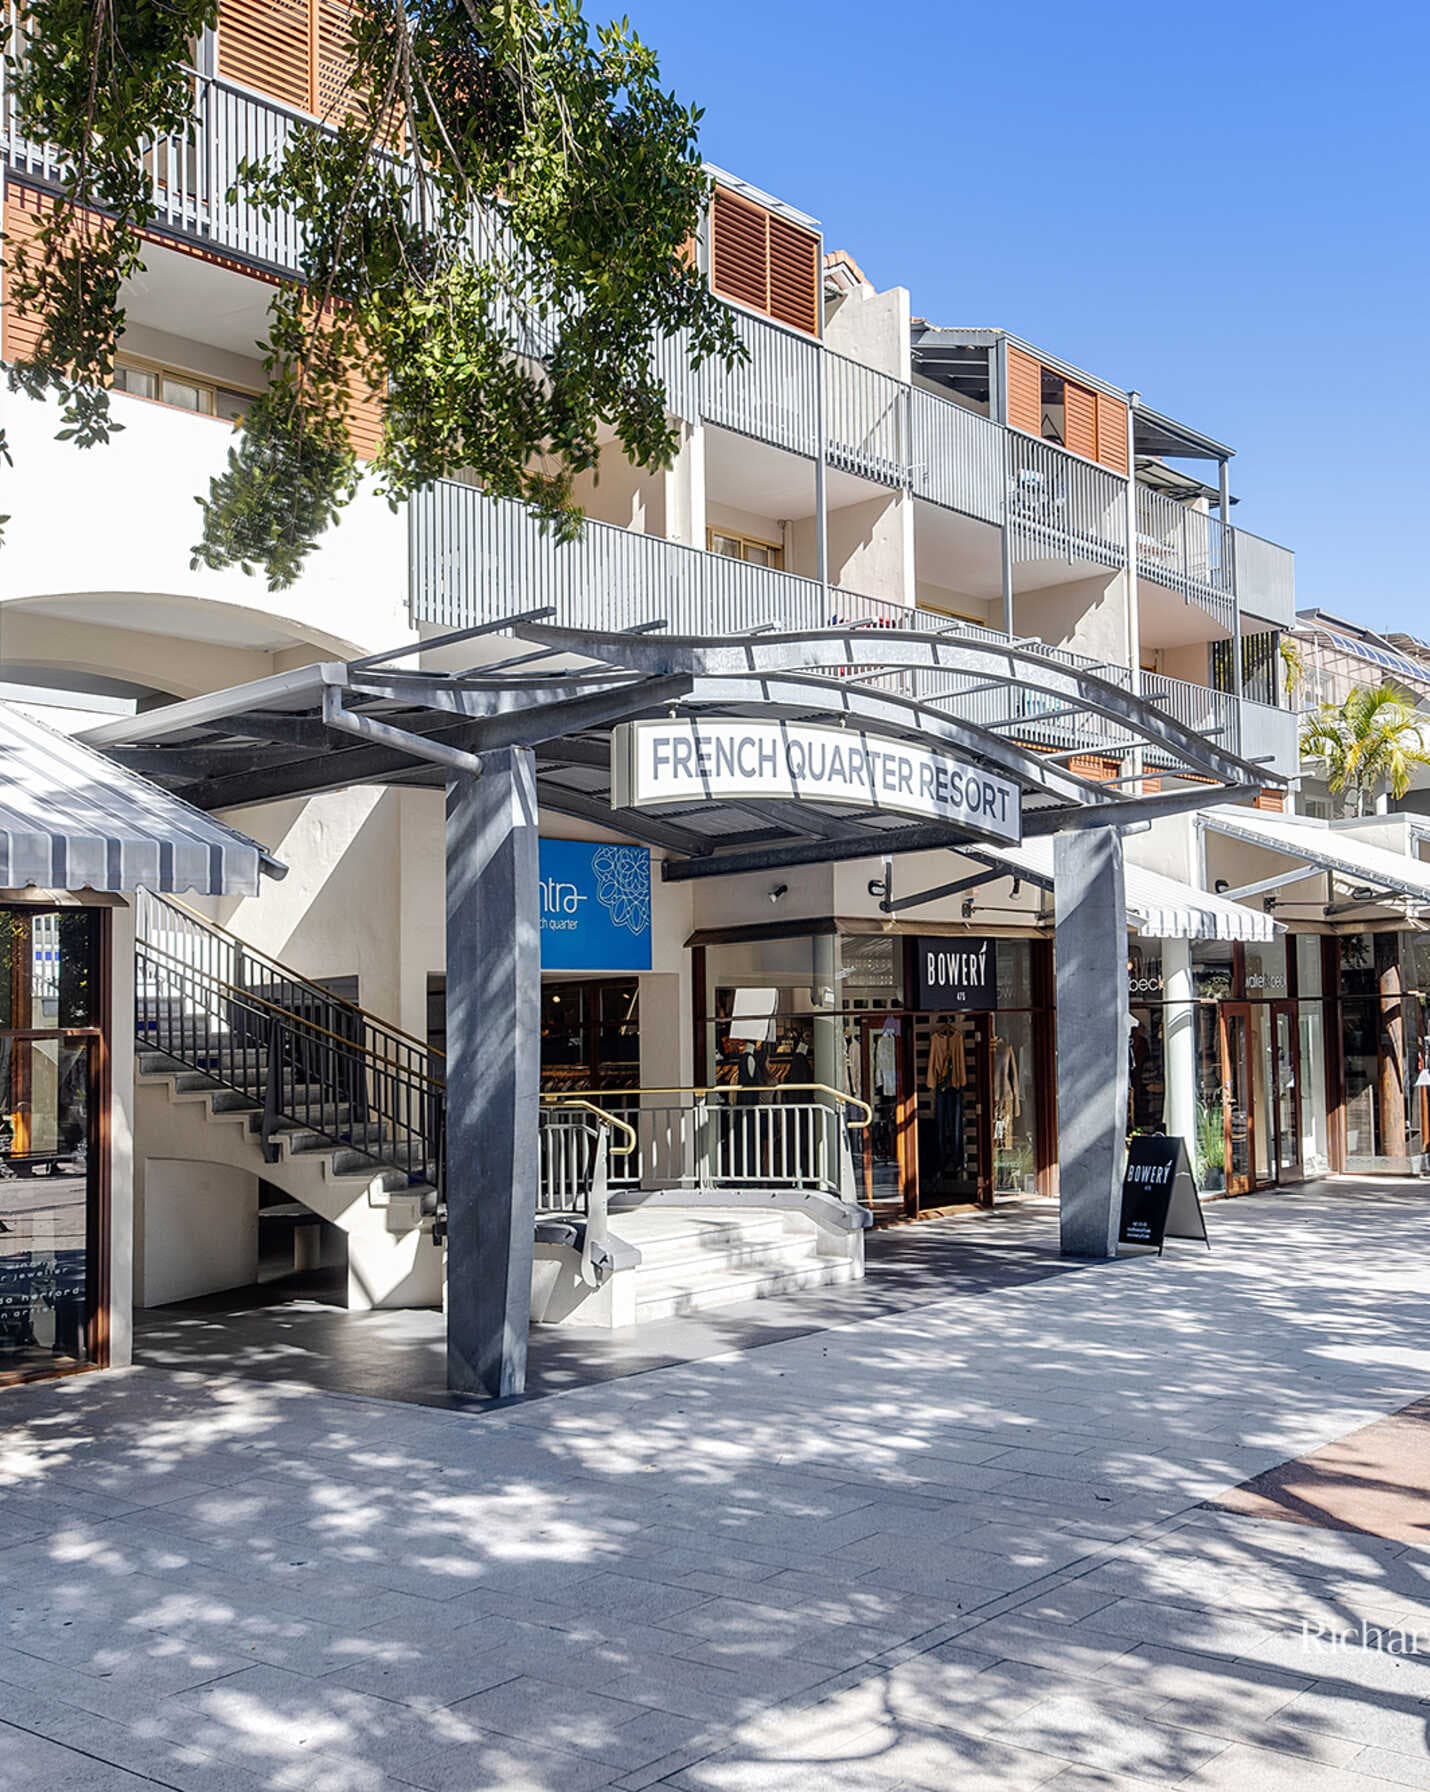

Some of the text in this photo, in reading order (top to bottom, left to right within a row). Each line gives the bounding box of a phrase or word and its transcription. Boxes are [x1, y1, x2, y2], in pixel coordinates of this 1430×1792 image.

[653, 736, 1010, 822] FRENCH QUARTER RESORT
[539, 877, 588, 913] ntra
